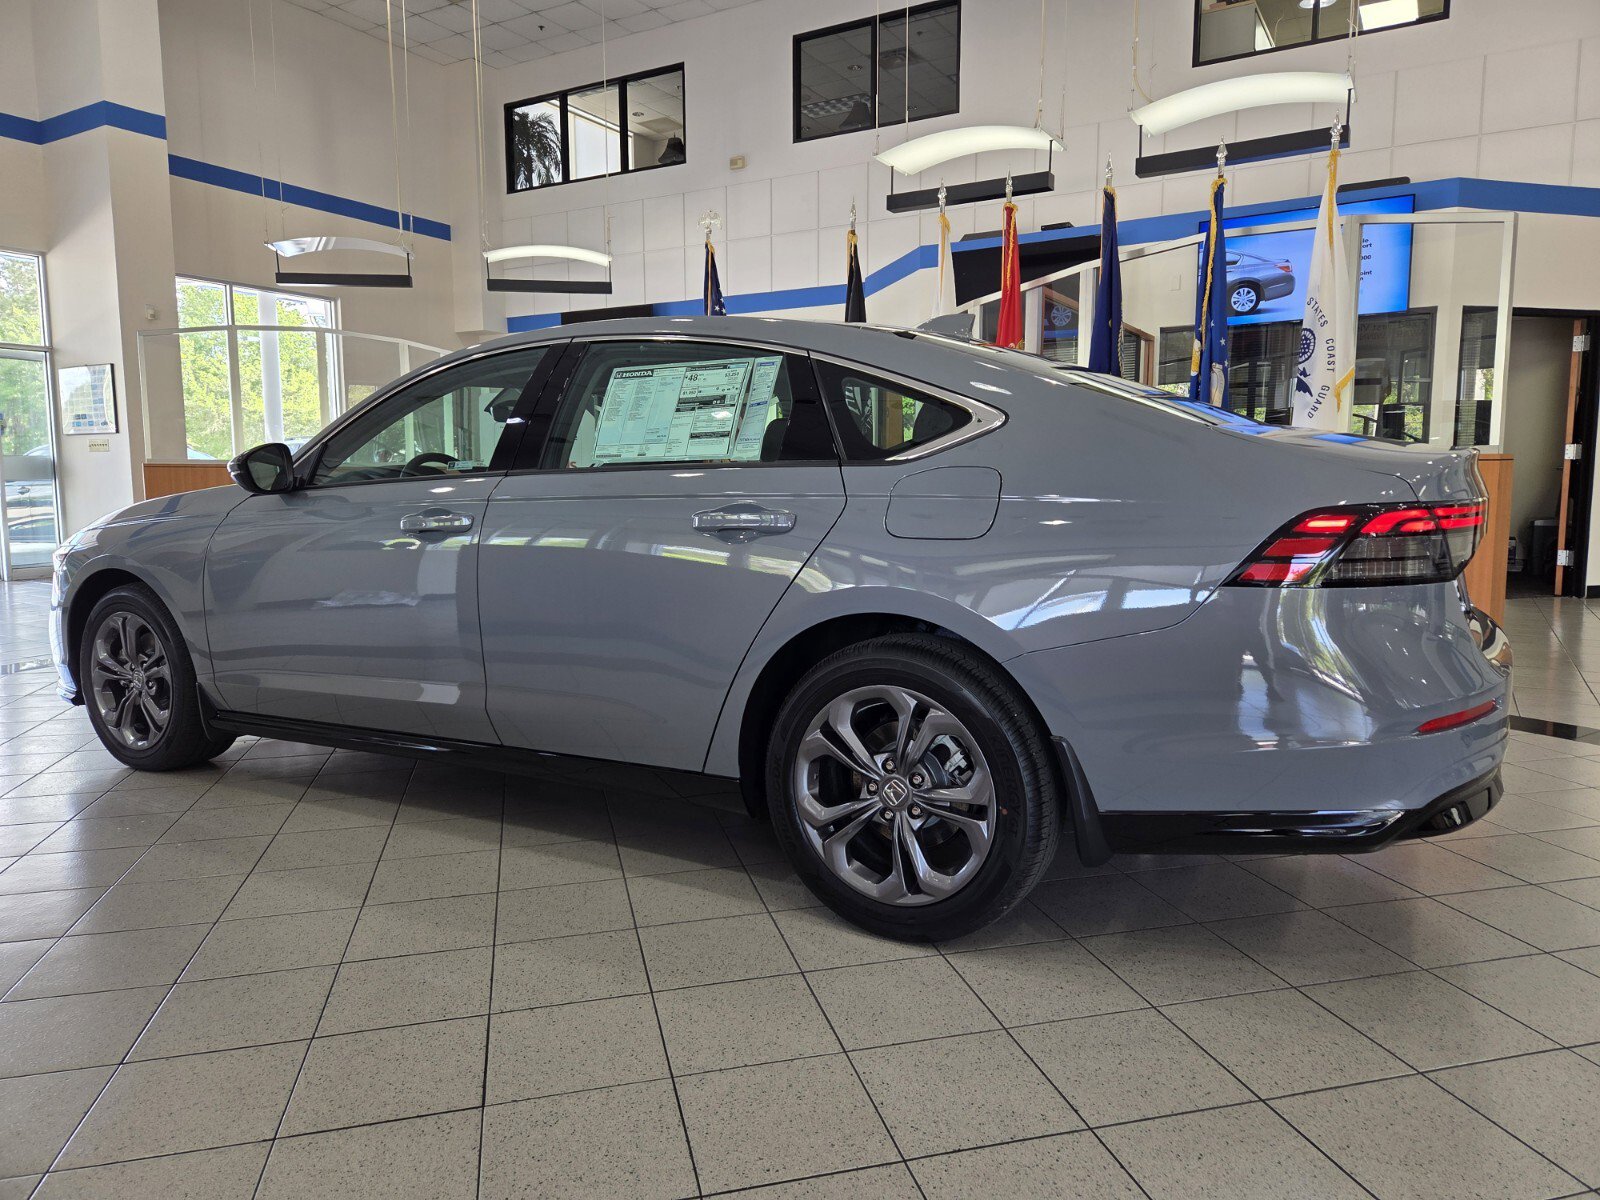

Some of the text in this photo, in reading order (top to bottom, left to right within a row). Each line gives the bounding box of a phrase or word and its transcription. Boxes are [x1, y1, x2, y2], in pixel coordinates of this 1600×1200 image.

[1306, 297, 1336, 419] STATES COAST GUARD
[622, 370, 653, 378] HONDA
[687, 373, 699, 382] 48
